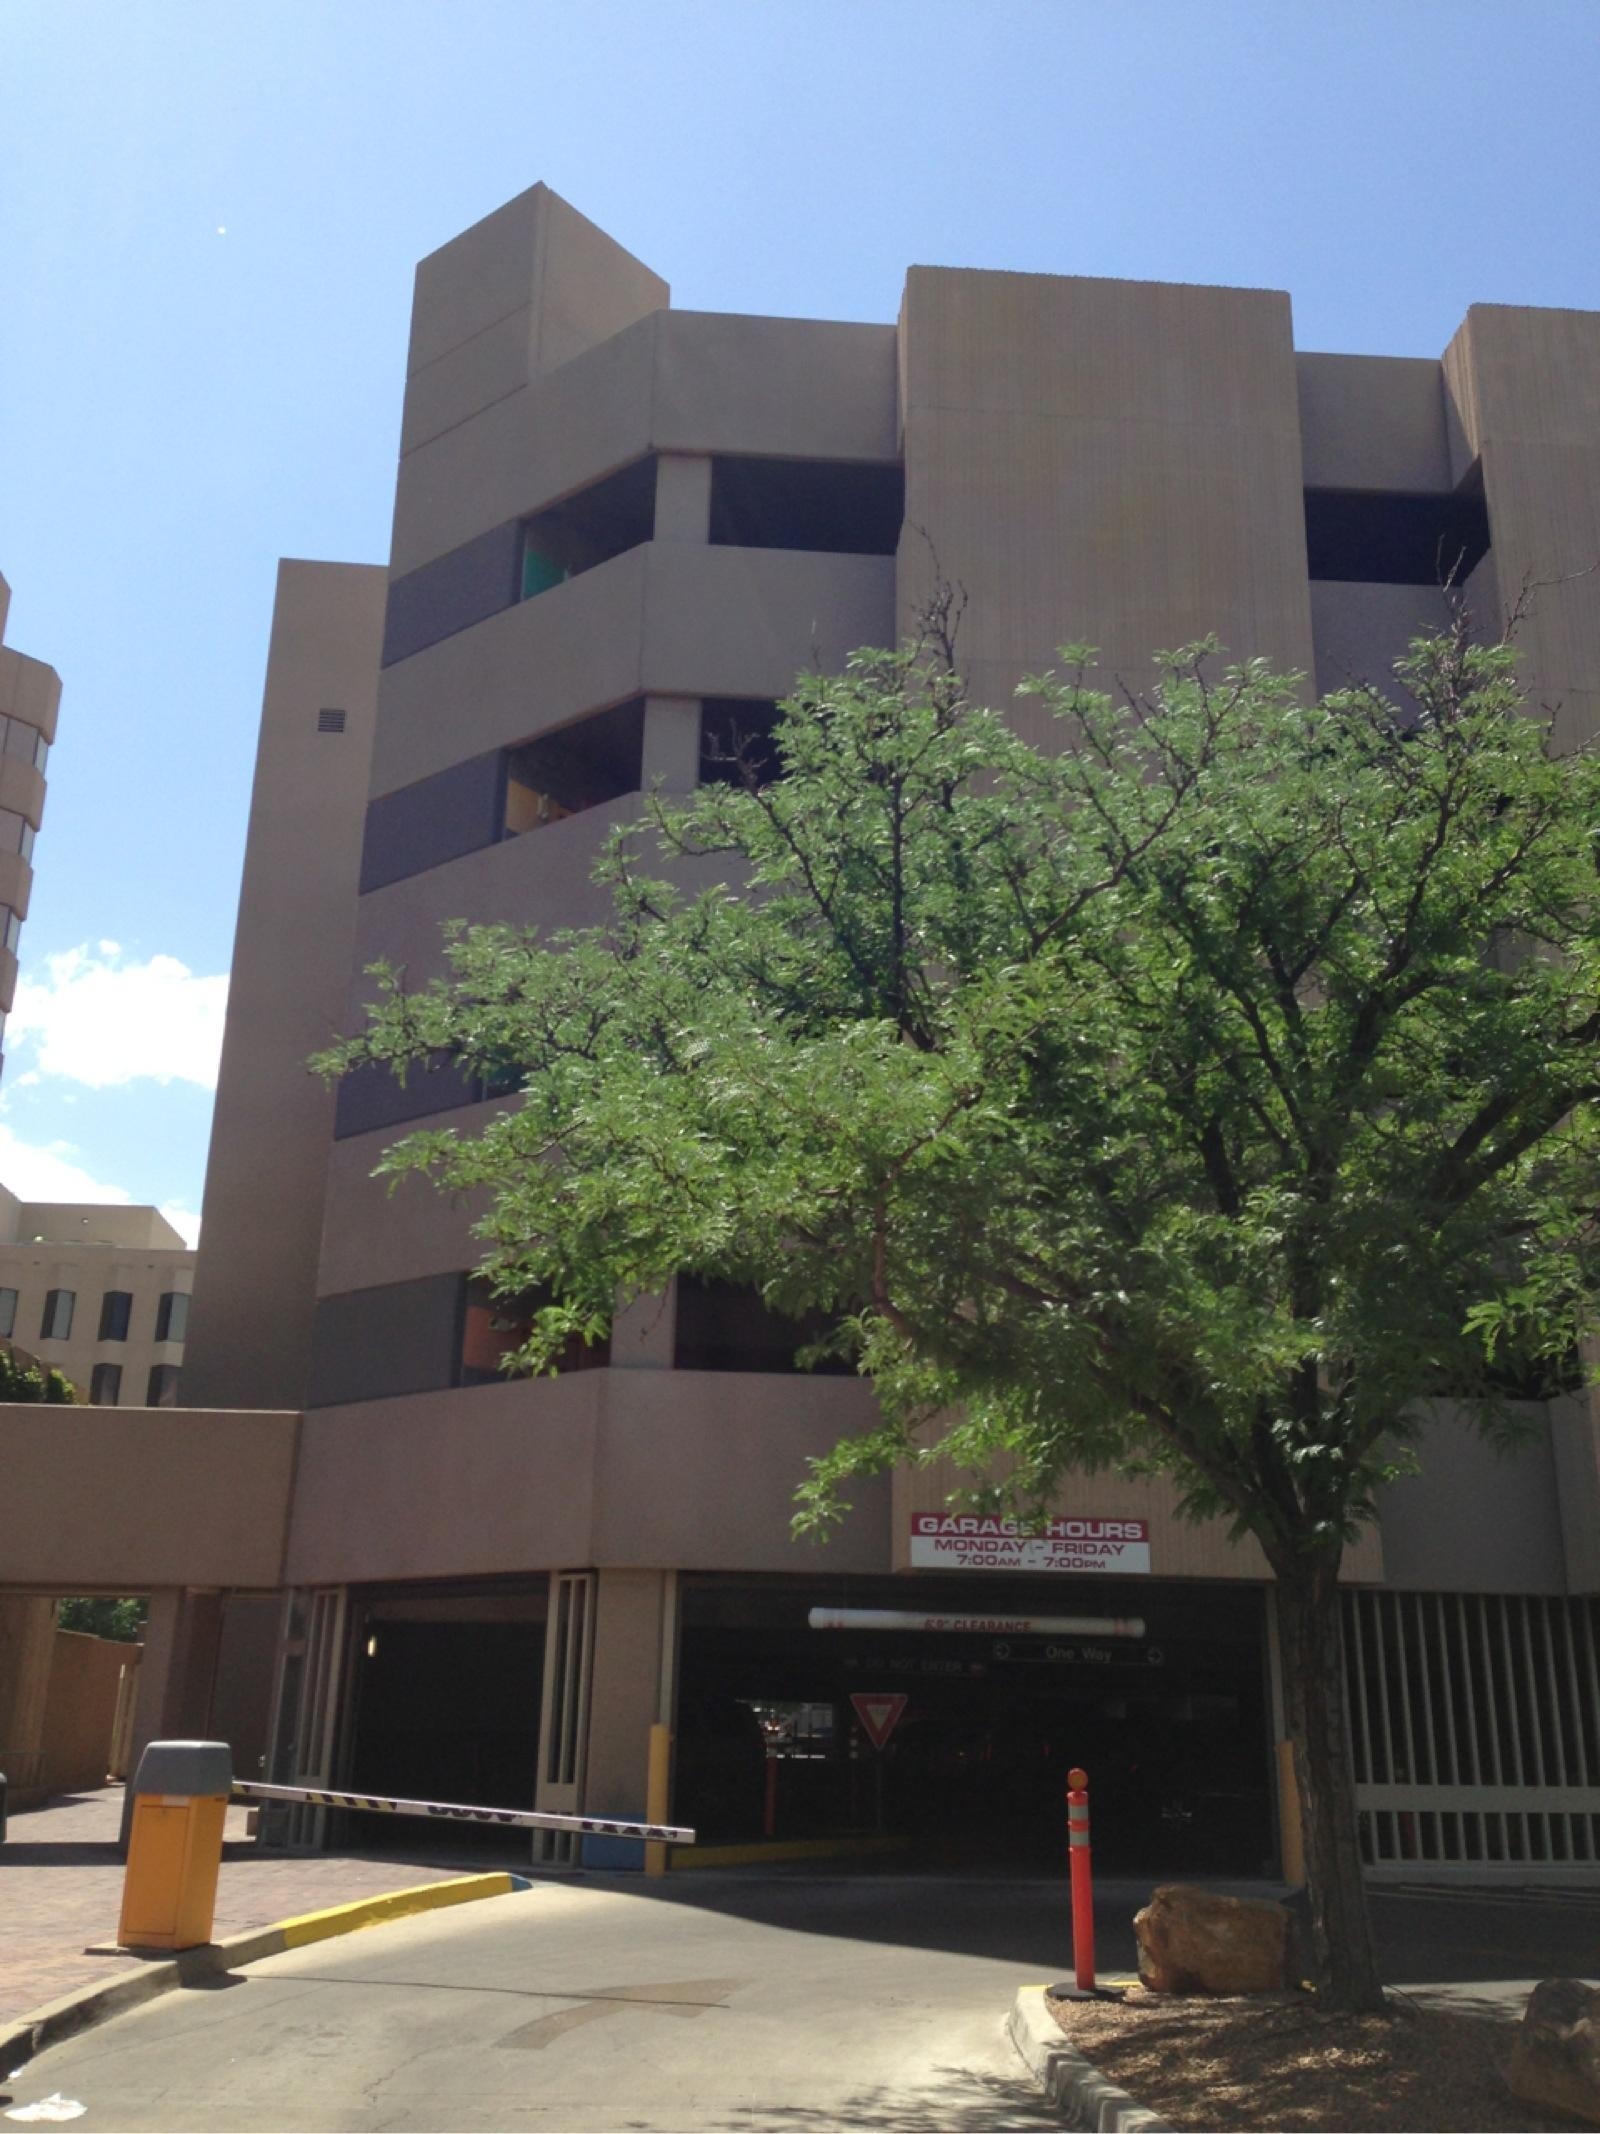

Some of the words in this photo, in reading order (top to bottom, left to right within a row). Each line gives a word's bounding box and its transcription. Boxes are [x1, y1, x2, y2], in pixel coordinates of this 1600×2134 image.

[919, 1517, 1036, 1537] GARAGE
[1046, 1521, 1143, 1539] HOURS
[934, 1539, 1027, 1553] MONDAY
[1052, 1542, 1126, 1556] FRIDAY
[956, 1554, 1021, 1567] 7:00AM
[1043, 1556, 1106, 1569] 7:00PM
[954, 1619, 1032, 1633] CLEARANCE
[1046, 1645, 1074, 1660] One
[1080, 1647, 1113, 1664] Way
